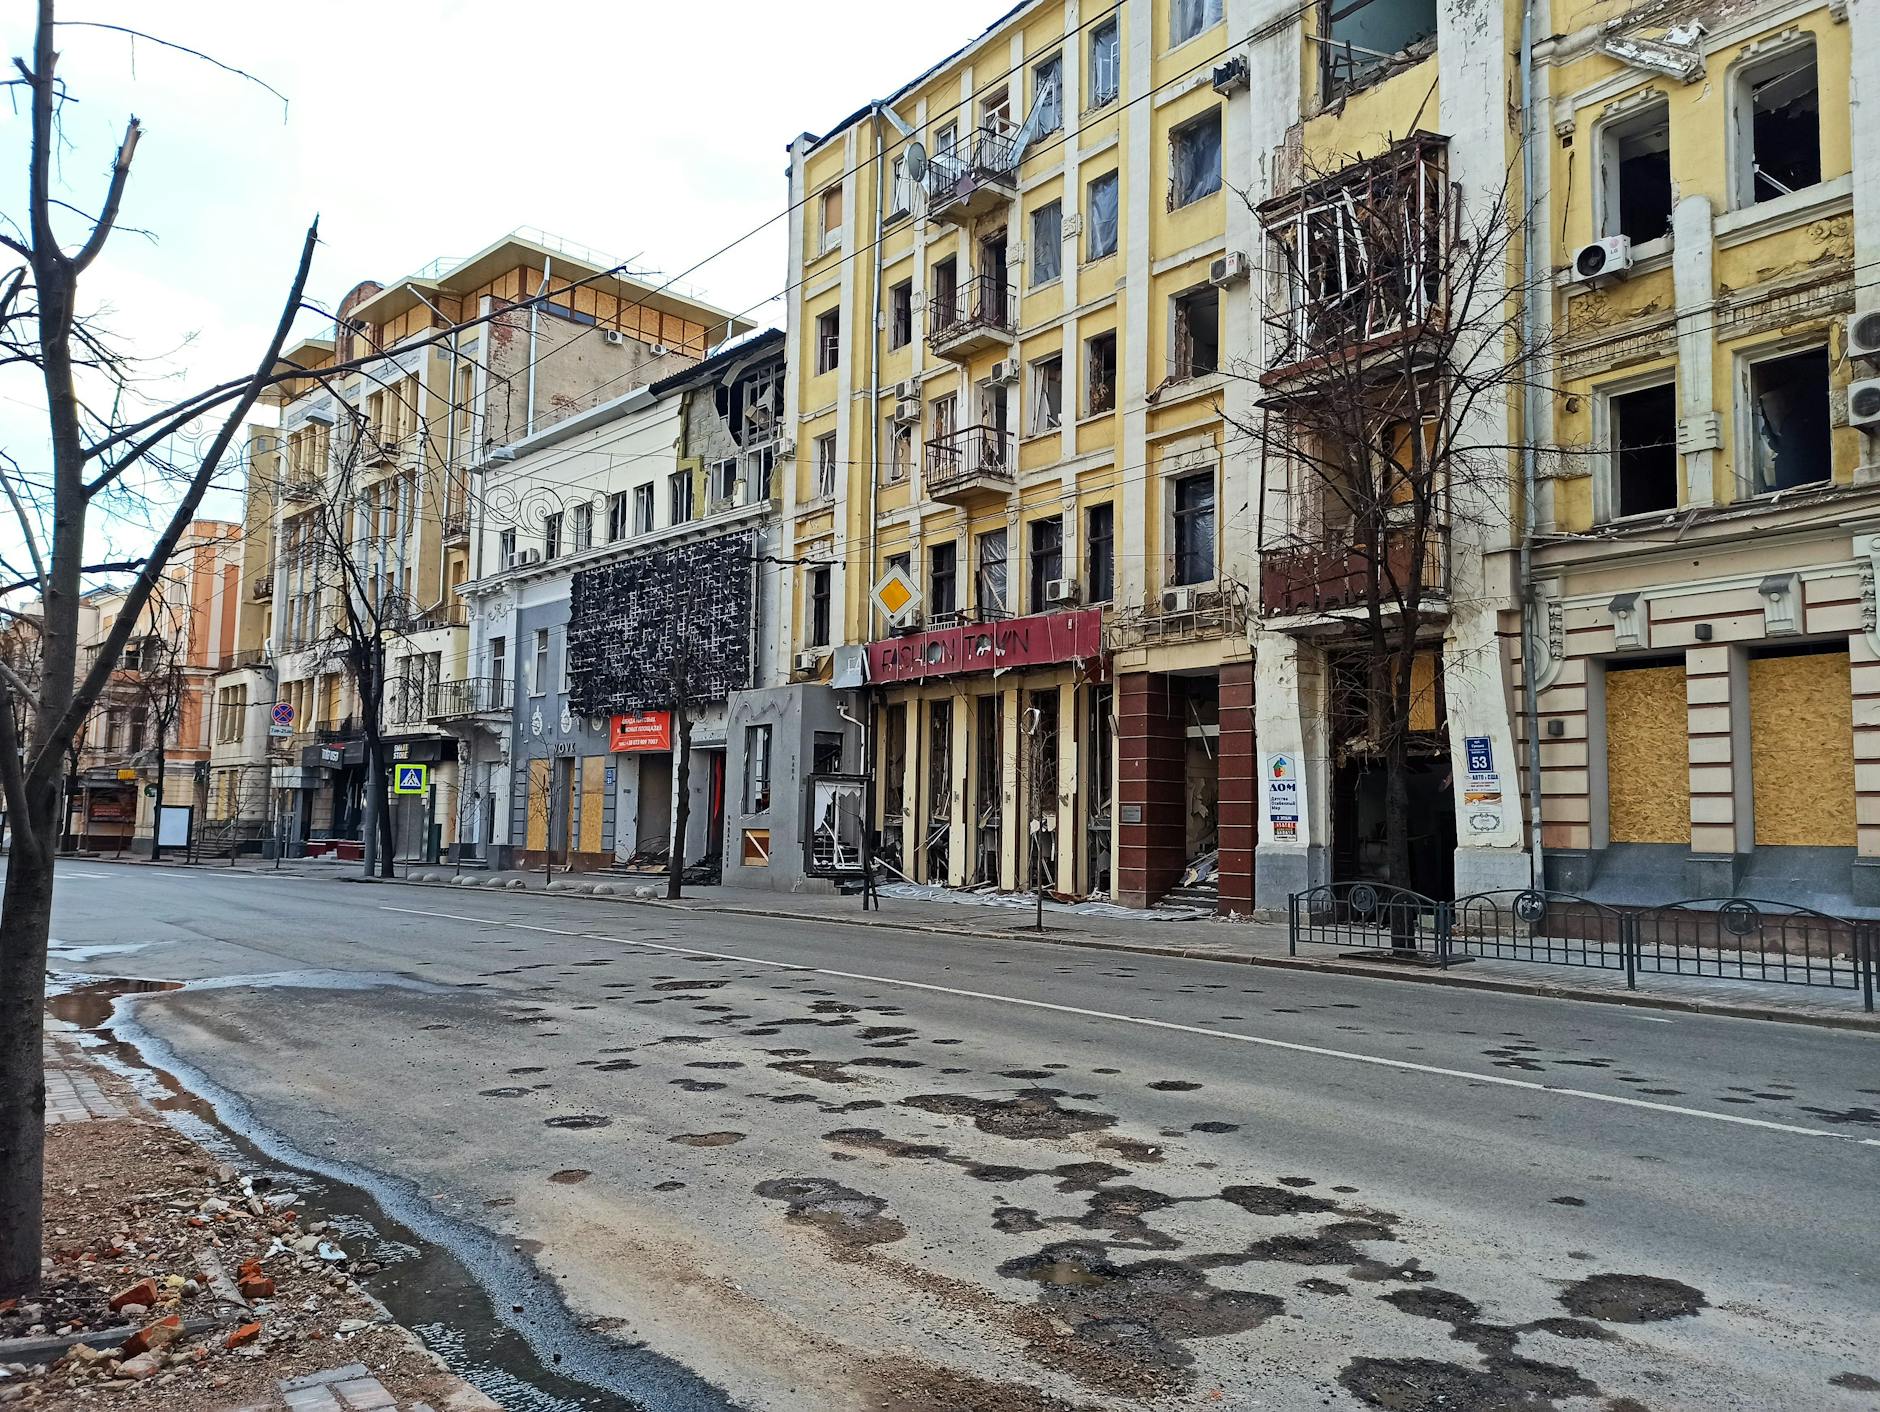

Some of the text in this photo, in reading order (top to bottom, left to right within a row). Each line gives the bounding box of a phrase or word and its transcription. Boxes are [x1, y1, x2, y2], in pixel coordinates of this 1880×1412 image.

[881, 628, 1030, 673] FASHION TOWN
[554, 742, 576, 753] VOVK
[1472, 756, 1488, 769] 53
[1270, 783, 1296, 791] ДОМ
